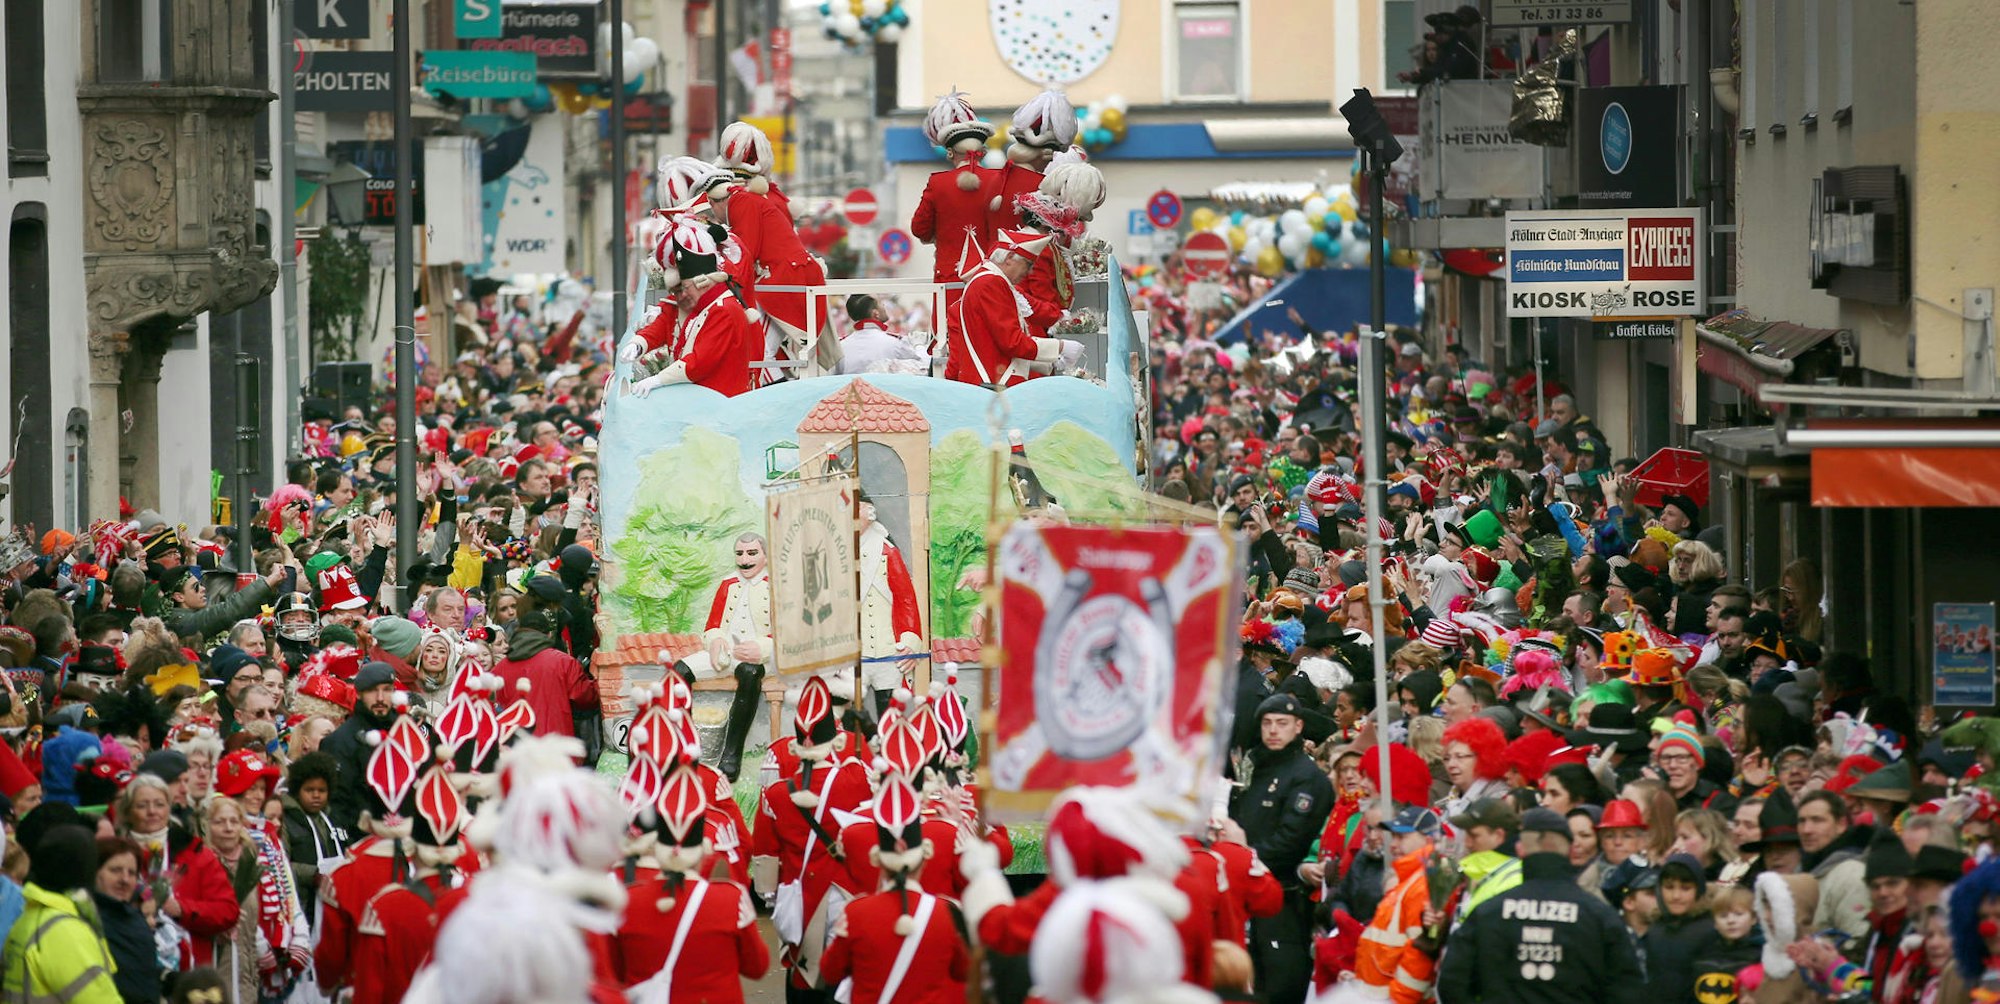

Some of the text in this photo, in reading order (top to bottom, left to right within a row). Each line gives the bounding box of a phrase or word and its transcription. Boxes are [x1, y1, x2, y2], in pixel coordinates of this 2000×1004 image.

[318, 0, 347, 27] K
[501, 11, 579, 27] rfümerie
[1520, 8, 1603, 20] Tel. 31 33 86
[294, 72, 390, 90] CHOLTEN
[427, 65, 533, 83] Reisebüro
[1510, 229, 1546, 242] Kölner
[506, 240, 546, 252] WDR
[1630, 227, 1691, 268] EXPRESS
[1512, 290, 1696, 309] KIOSK ROSE
[1616, 323, 1677, 338] Gaffel Kölsc
[1502, 899, 1578, 923] POLIZEI
[1517, 943, 1563, 962] 31231
